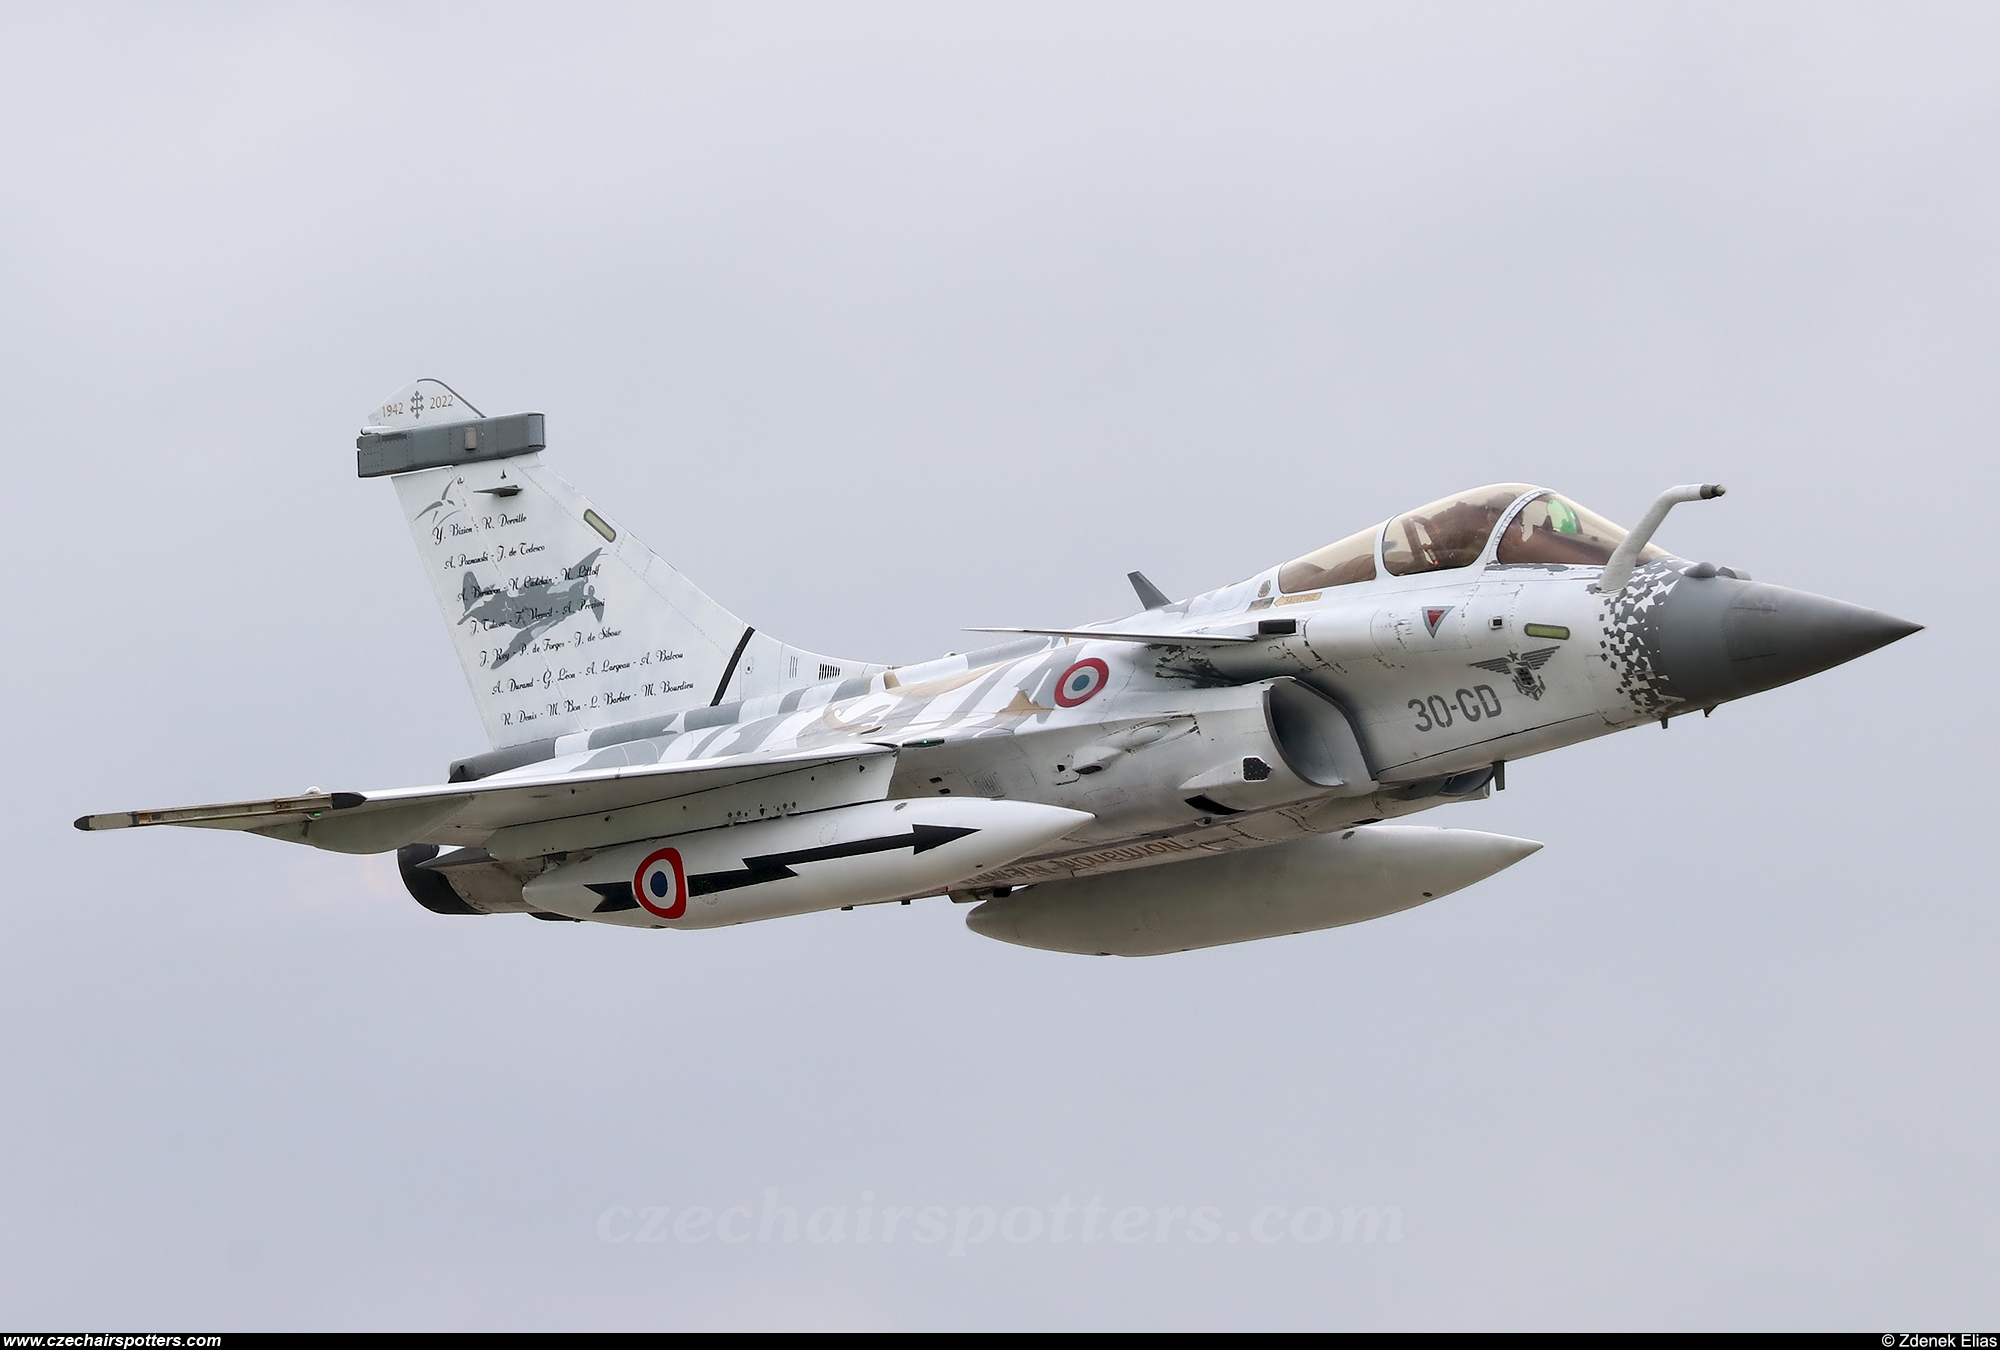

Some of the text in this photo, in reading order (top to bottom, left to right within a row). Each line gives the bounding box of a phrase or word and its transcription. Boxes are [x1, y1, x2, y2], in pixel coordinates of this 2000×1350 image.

[382, 395, 454, 418] 1942 2022
[431, 526, 447, 545] Y.
[449, 523, 473, 536] Bizien
[482, 516, 495, 529] R.
[444, 555, 456, 570] A.
[508, 547, 517, 557] de
[562, 601, 575, 615] A.
[491, 648, 510, 662] Rey
[518, 643, 529, 656] P.
[532, 643, 540, 653] de
[542, 638, 565, 652] Forges
[587, 632, 596, 642] de
[491, 680, 504, 695] A.
[507, 677, 534, 692] Durand
[542, 669, 554, 689] G.
[585, 662, 598, 676] A.
[601, 659, 631, 673] Largeau
[639, 652, 652, 666] A.
[656, 649, 684, 662] Balcou
[501, 712, 513, 726] R.
[516, 709, 537, 724] Denis
[546, 702, 561, 716] M.
[564, 699, 581, 713] Bon
[589, 695, 600, 709] L.
[603, 691, 631, 705] Barbier
[641, 683, 657, 697] M.
[660, 680, 694, 693] Bourdieu
[1407, 684, 1502, 733] 30-GD
